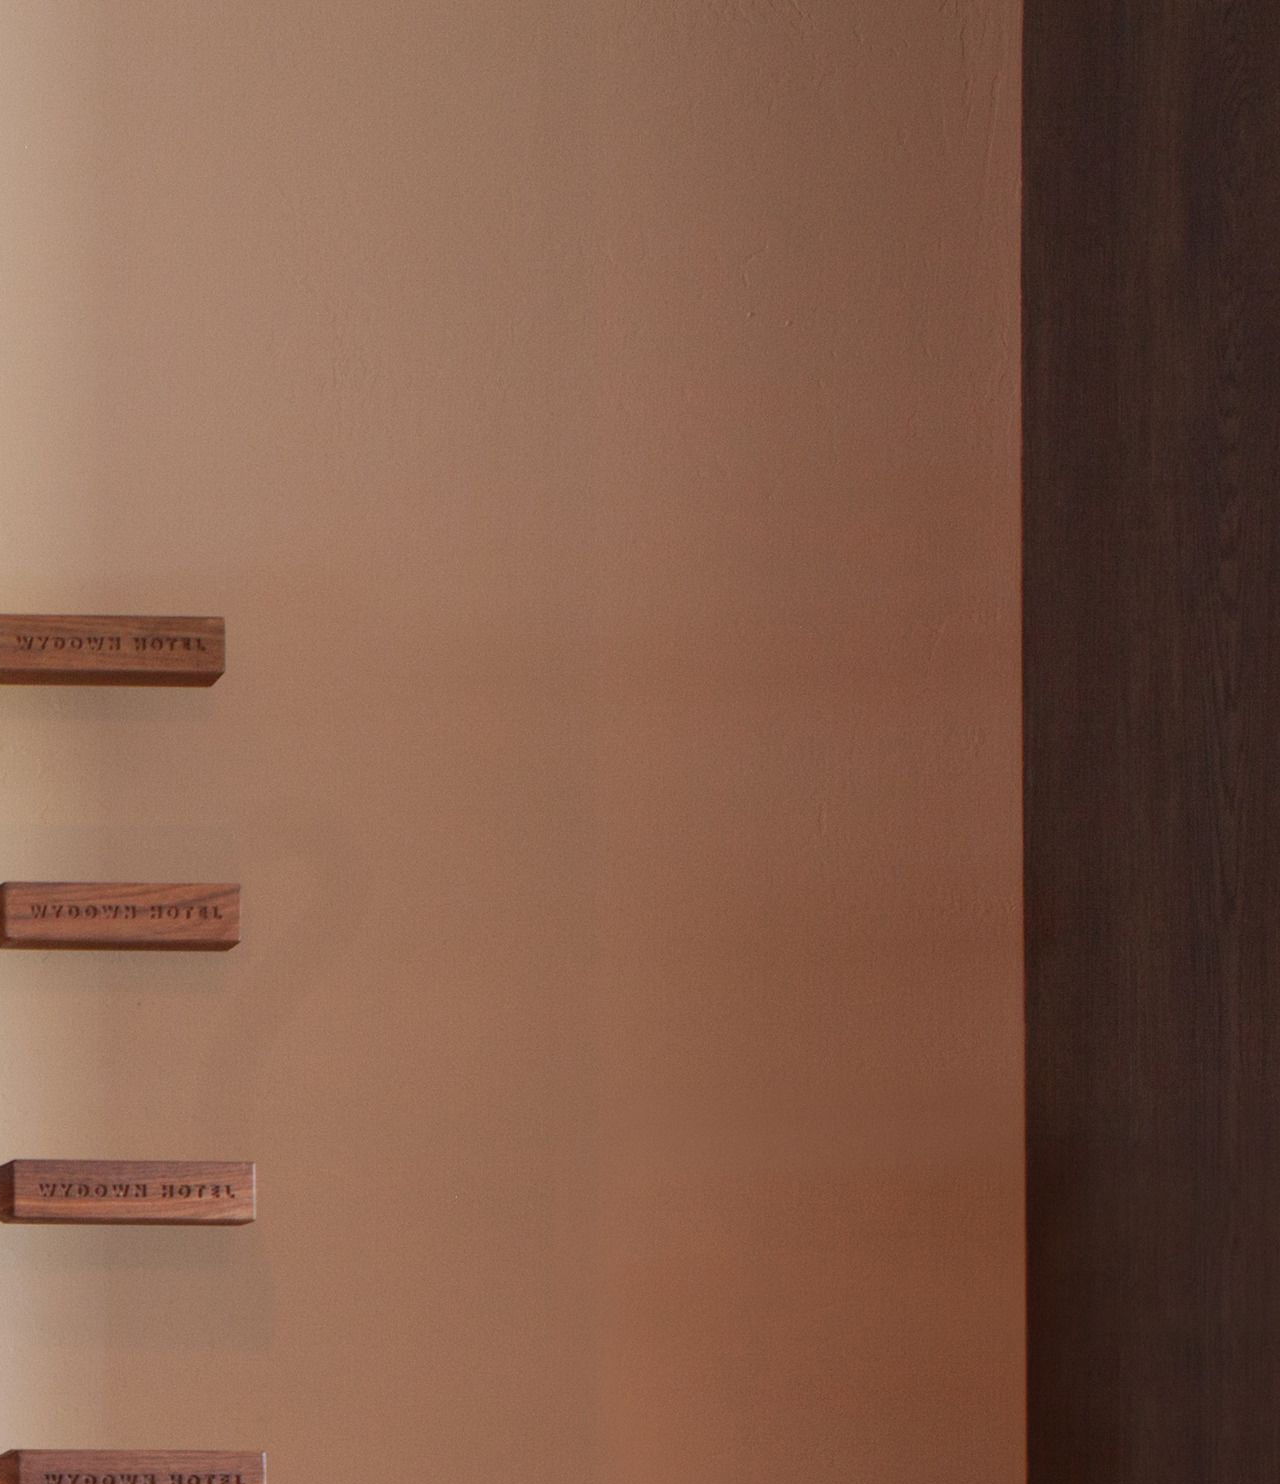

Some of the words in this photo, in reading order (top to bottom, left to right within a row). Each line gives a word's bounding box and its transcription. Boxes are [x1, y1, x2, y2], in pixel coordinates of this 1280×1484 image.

[16, 635, 122, 651] WYDOWN
[134, 636, 207, 652] HOTEL
[30, 904, 137, 920] WYDOWN
[150, 904, 224, 920] HOTEL
[38, 1183, 148, 1199] WYDOWN
[161, 1183, 236, 1199] HOTEL
